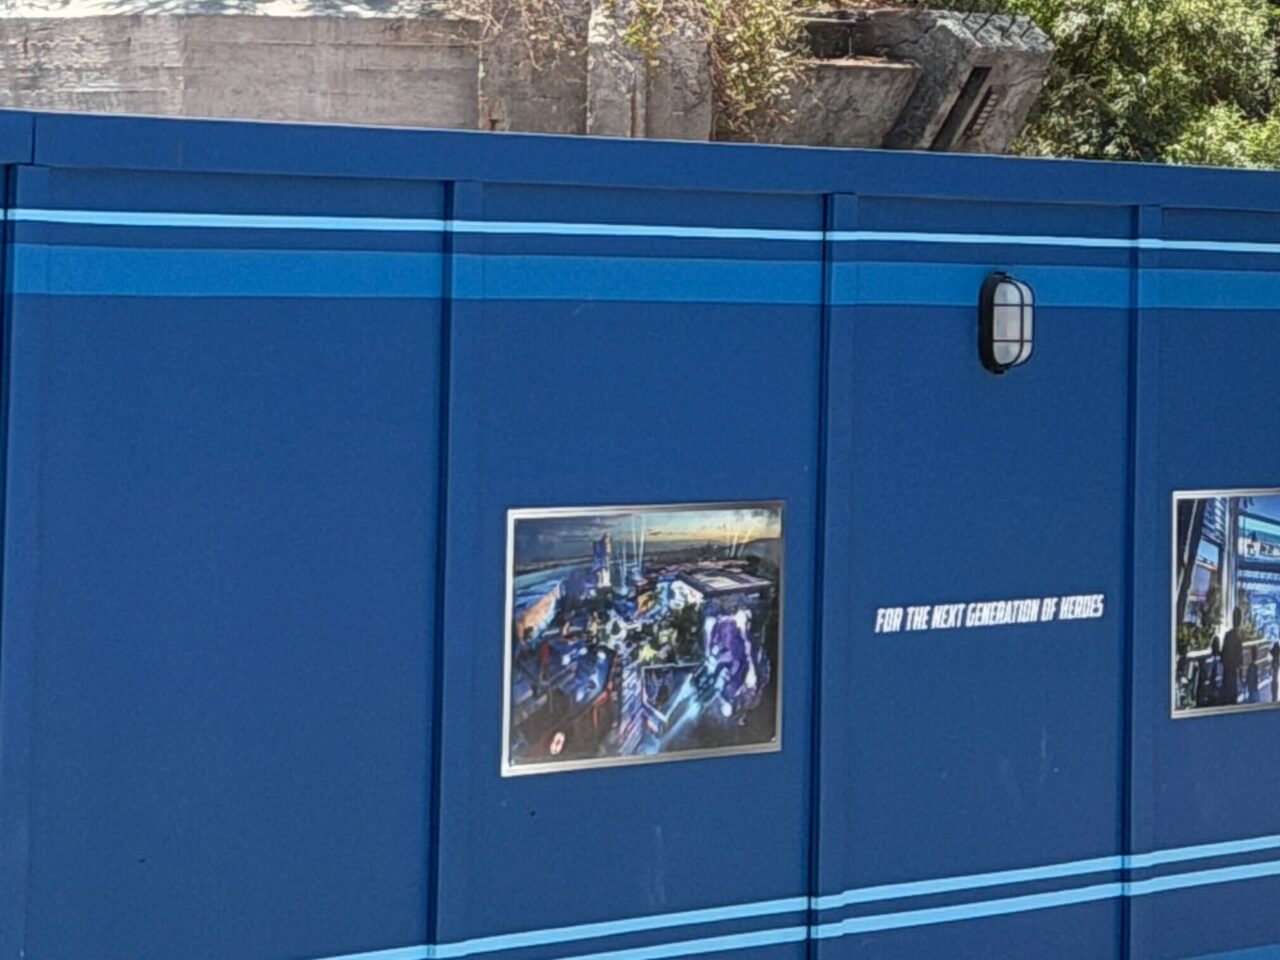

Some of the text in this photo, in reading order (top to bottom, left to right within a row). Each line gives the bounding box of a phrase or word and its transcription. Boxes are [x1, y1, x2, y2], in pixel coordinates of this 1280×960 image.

[875, 594, 1104, 633] FOR THE NEXT GENERATION OF HEROES
